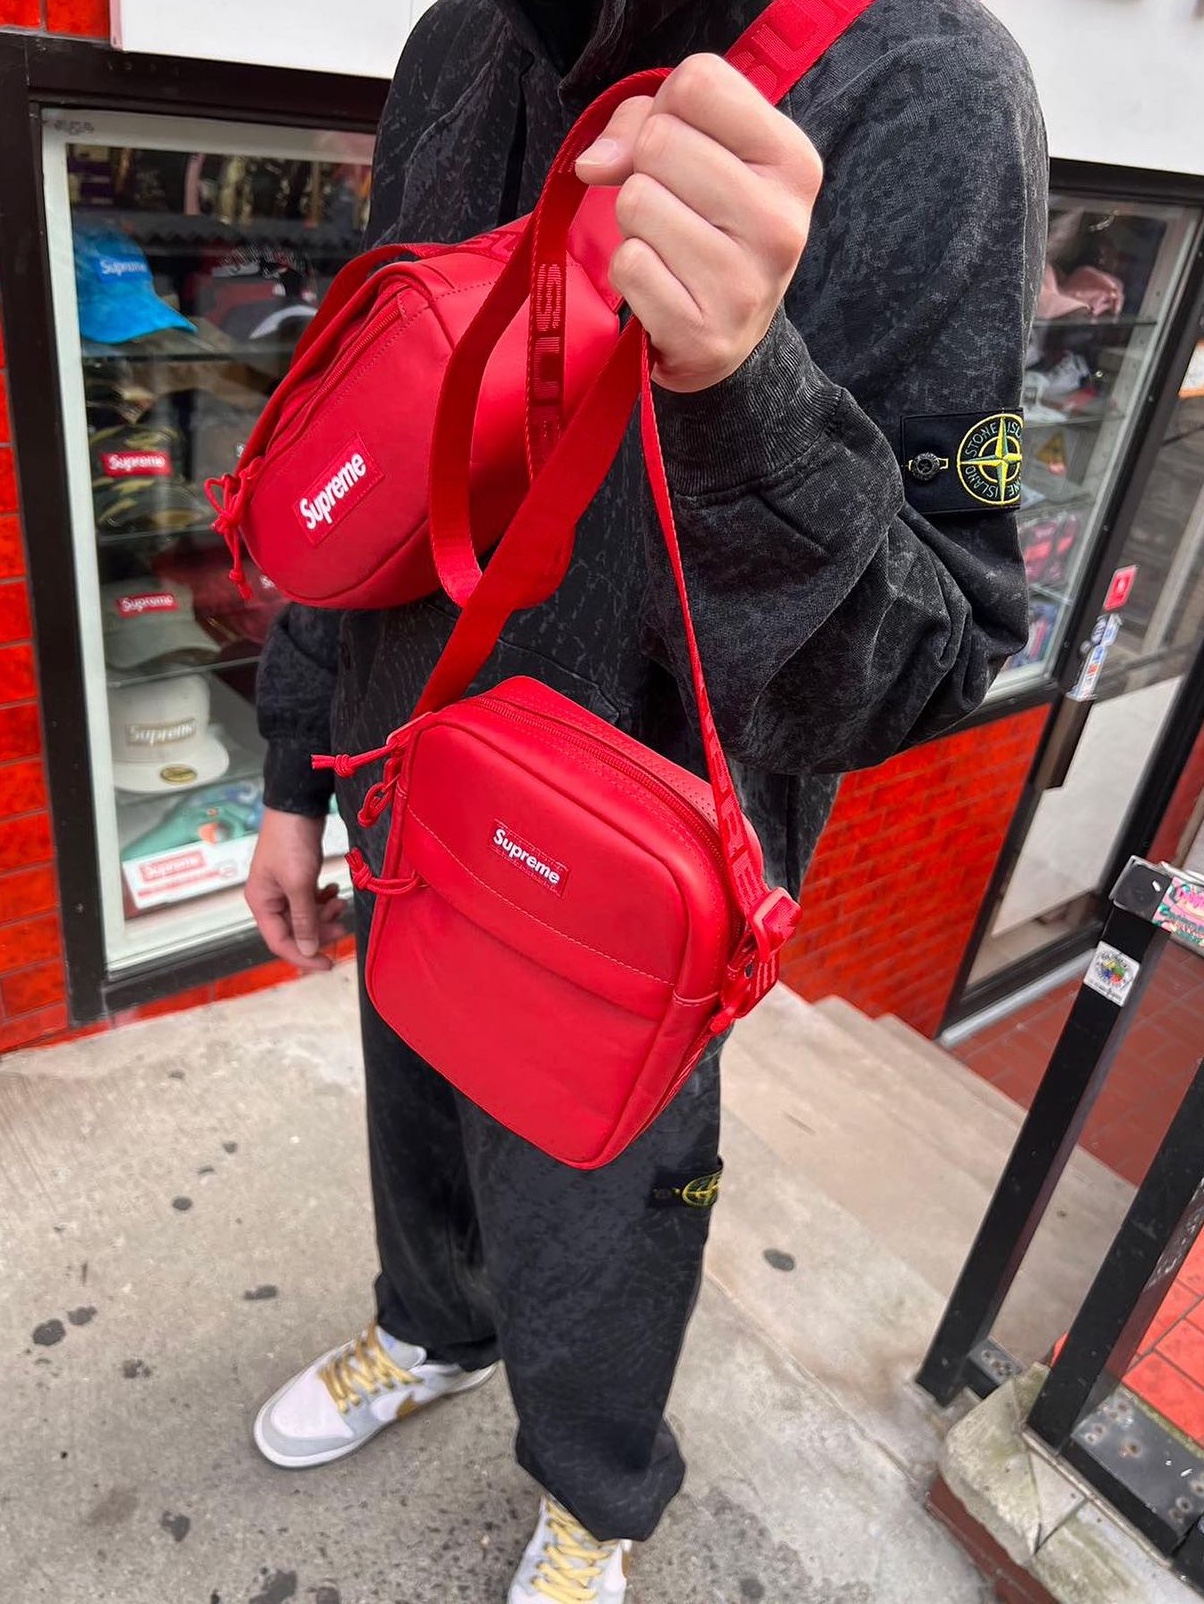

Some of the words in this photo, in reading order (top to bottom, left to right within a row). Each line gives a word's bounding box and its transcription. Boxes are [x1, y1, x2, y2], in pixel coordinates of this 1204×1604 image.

[964, 421, 998, 458] STONE
[1006, 421, 1021, 438] ISL
[107, 454, 167, 473] Supreme
[299, 452, 367, 530] Supreme
[964, 465, 999, 498] ISLAND
[119, 593, 175, 613] Supreme
[493, 828, 561, 884] Supreme
